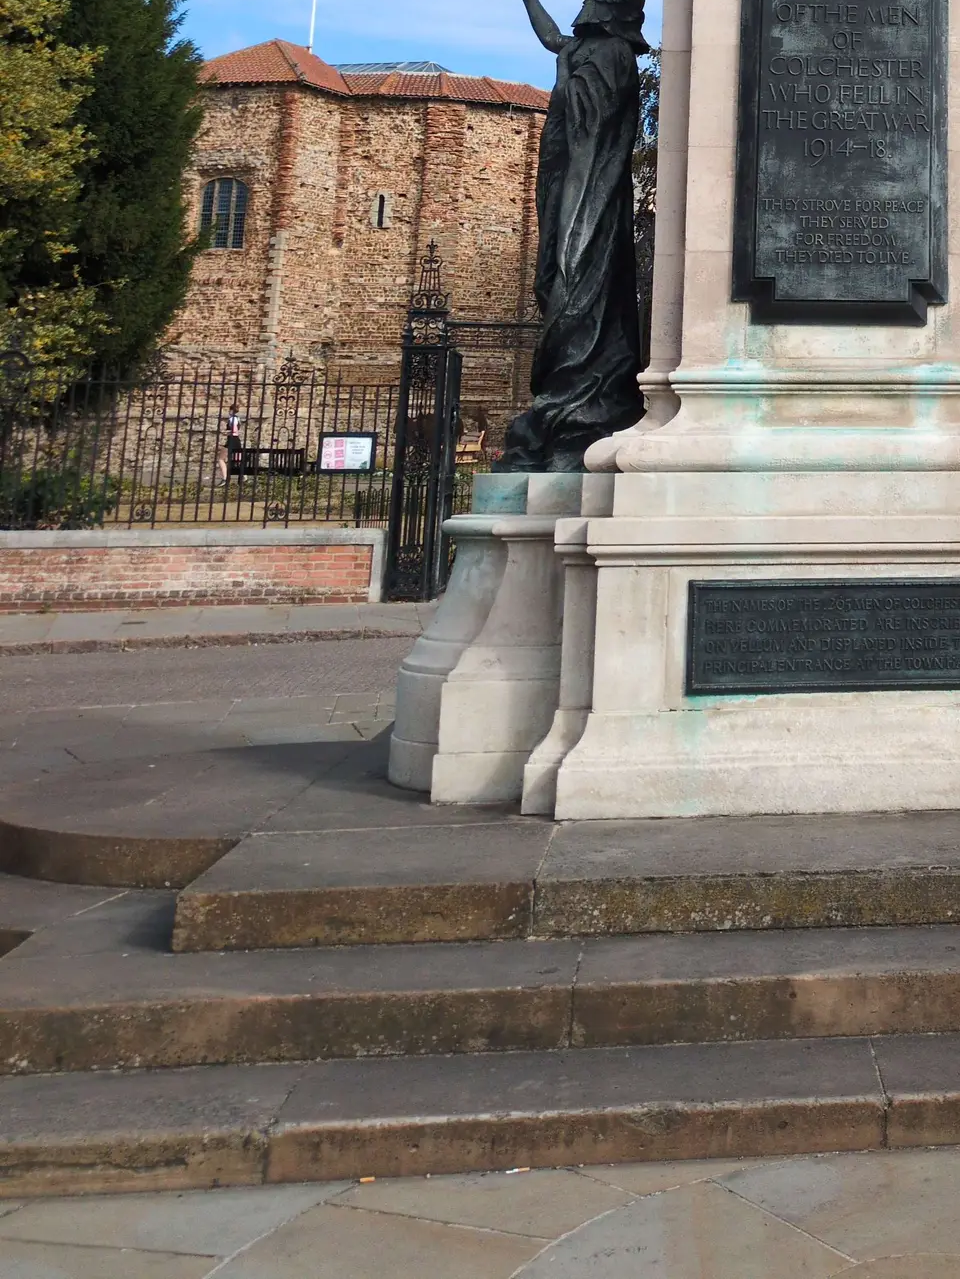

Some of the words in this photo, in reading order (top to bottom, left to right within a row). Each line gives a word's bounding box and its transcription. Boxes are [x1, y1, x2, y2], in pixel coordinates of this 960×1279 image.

[776, 2, 807, 23] OF
[808, 3, 859, 24] THE
[864, 5, 920, 26] MEN
[832, 30, 863, 51] OF
[769, 55, 926, 80] COLCHESTER
[769, 82, 831, 104] WHO
[839, 84, 891, 106] FELL
[896, 86, 926, 107] IN
[761, 108, 809, 131] THE
[811, 109, 880, 132] GREAT
[882, 111, 931, 134] WAR
[762, 197, 801, 212] THEY
[802, 197, 851, 213] STROVE
[855, 199, 882, 213] FOR
[885, 199, 925, 214] PEACE
[800, 215, 837, 229] THEY
[839, 216, 890, 230] SERVED
[795, 232, 824, 246] FOR
[827, 233, 897, 247] FREEDOM
[775, 249, 817, 264] THEY
[818, 249, 854, 264] DIED
[856, 250, 877, 264] TO
[705, 598, 731, 614] THE
[732, 598, 775, 613] NAMES
[776, 598, 794, 612] OF
[798, 597, 821, 611] THE
[823, 595, 852, 613] 265
[853, 597, 881, 612] MEN
[884, 597, 901, 611] OF
[746, 617, 870, 634] COMMEMORATED
[875, 616, 902, 632] ARE
[704, 639, 730, 654] ON
[731, 638, 785, 654] VELLUM
[788, 637, 819, 653] AND
[820, 636, 898, 653] DISPLAYED
[899, 635, 949, 652] INSIDE
[703, 658, 774, 675] PRINCIPAL
[775, 657, 853, 673] ENTRANCE
[903, 656, 945, 671] TOWN
